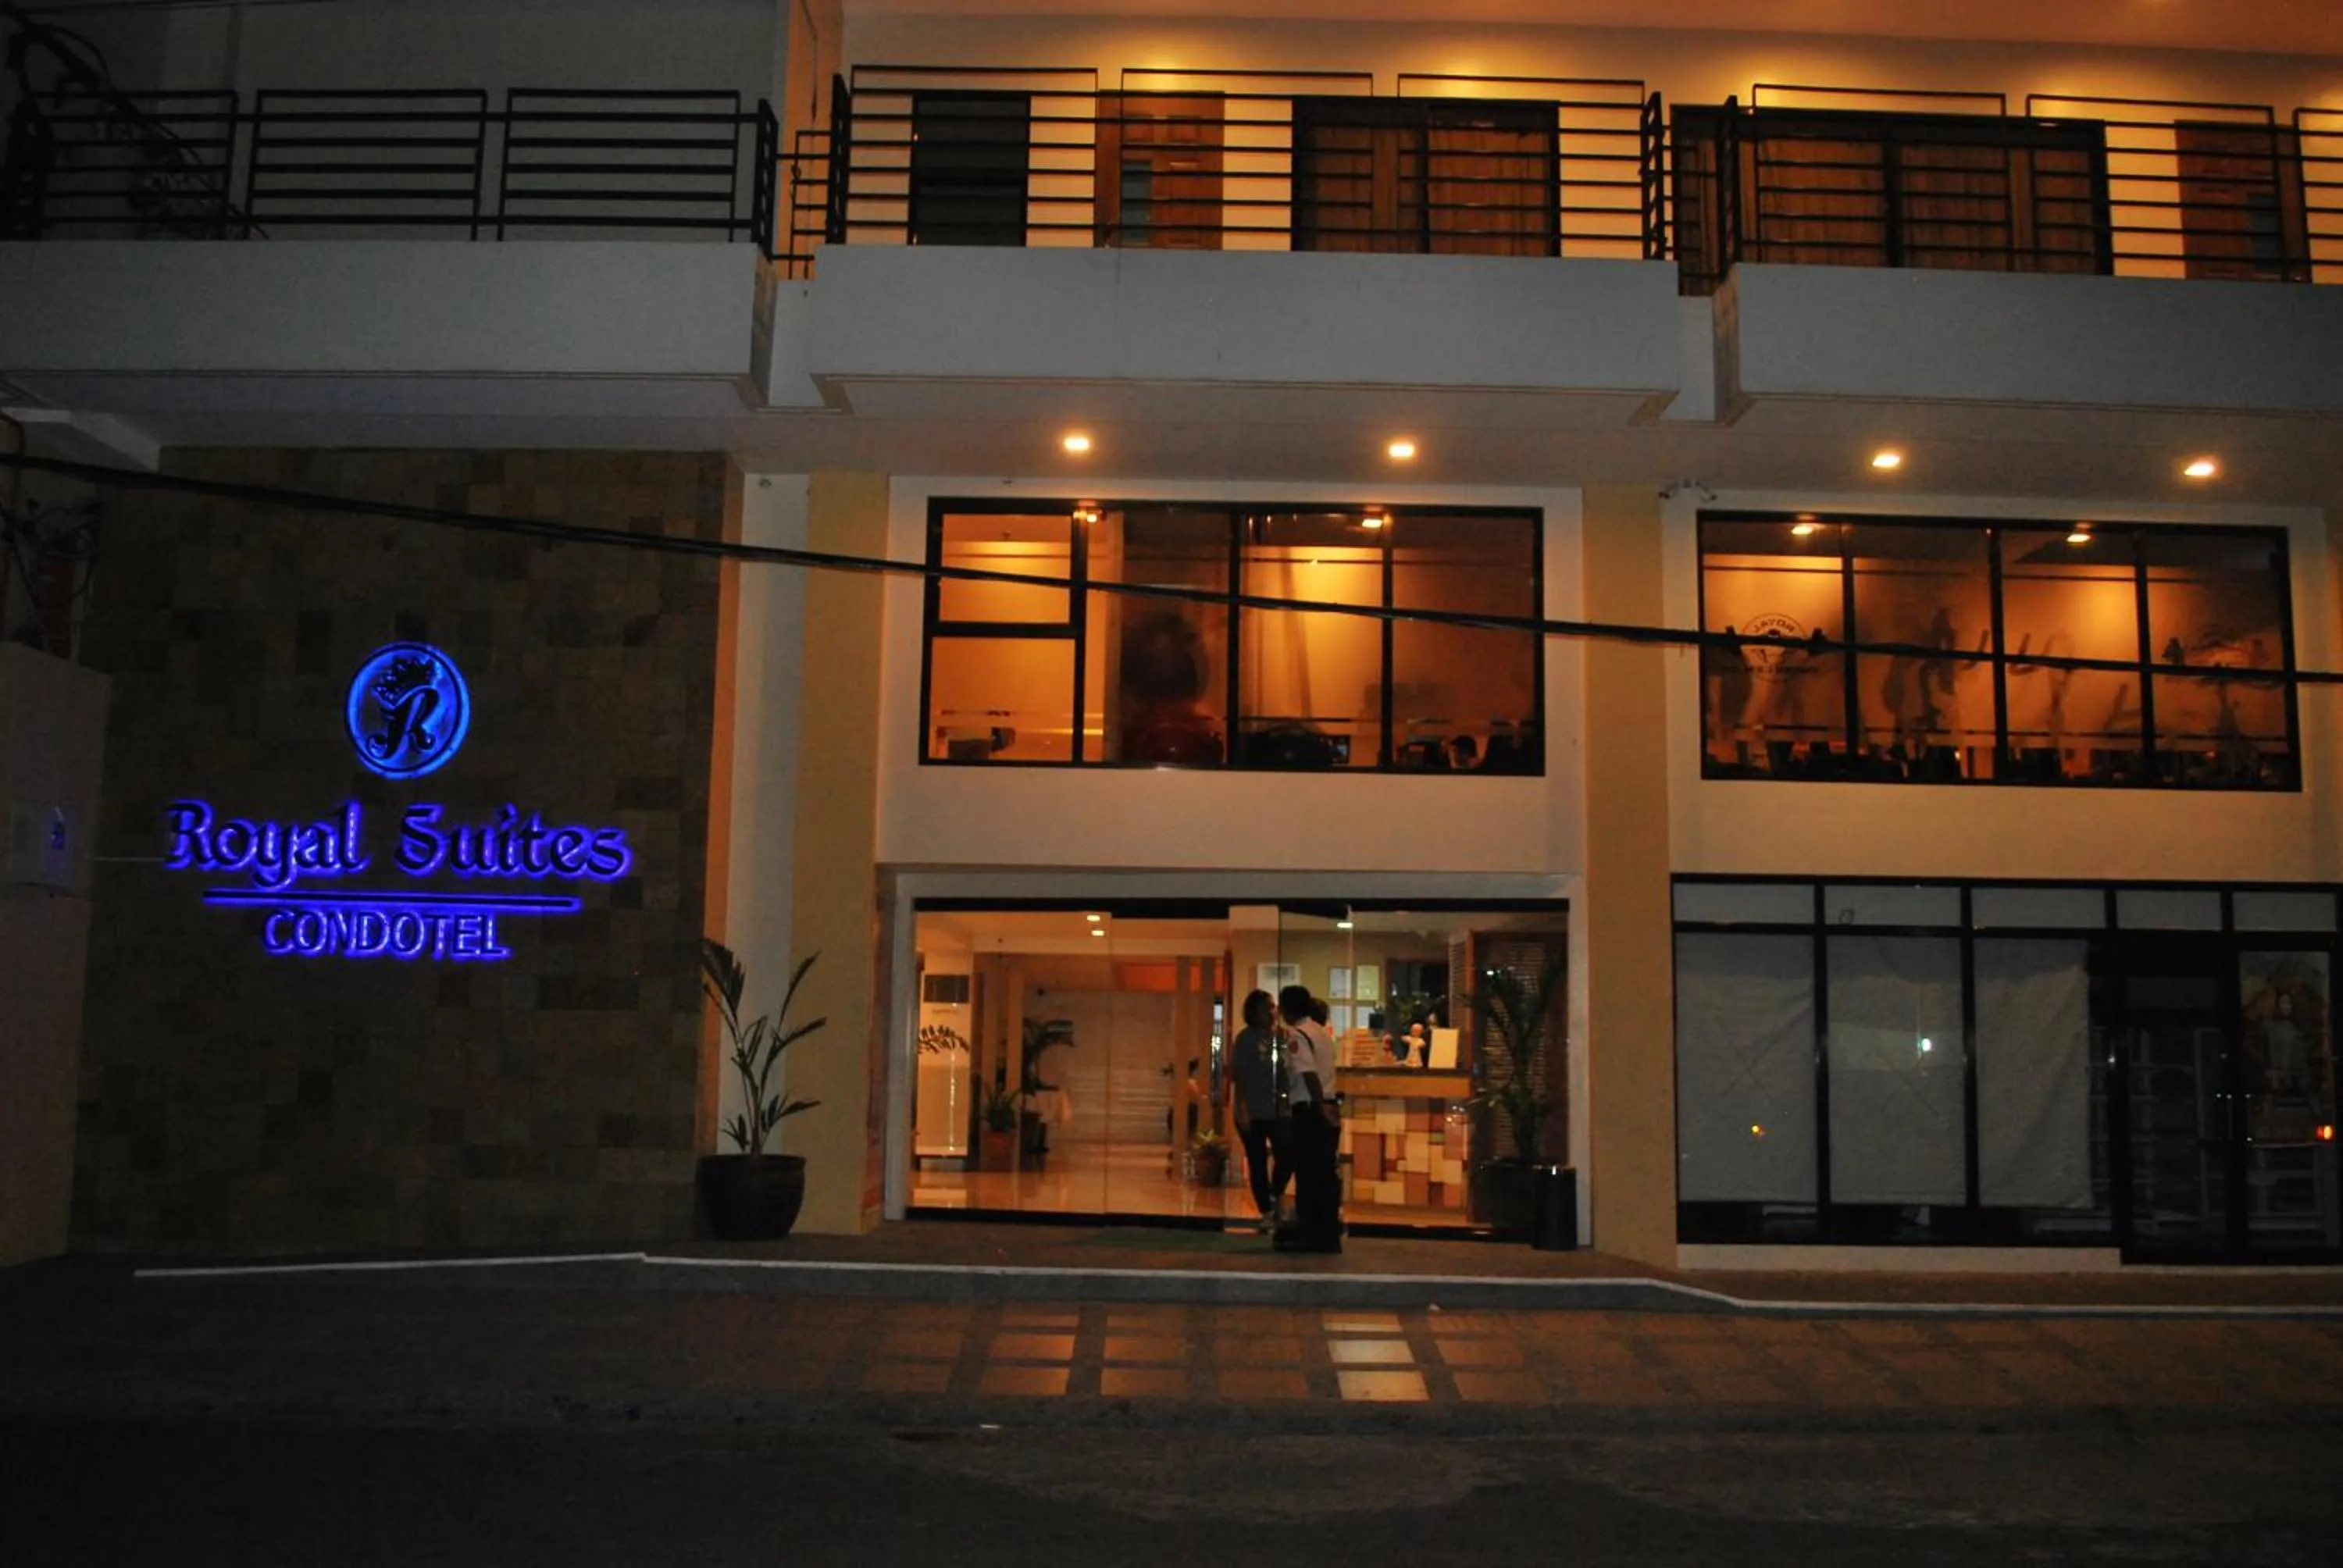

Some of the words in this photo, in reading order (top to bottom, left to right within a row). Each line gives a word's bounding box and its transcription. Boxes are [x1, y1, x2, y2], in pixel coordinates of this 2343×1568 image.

[166, 799, 369, 889] Royal
[395, 803, 632, 880] Suites
[263, 909, 509, 960] CONDOTEL
